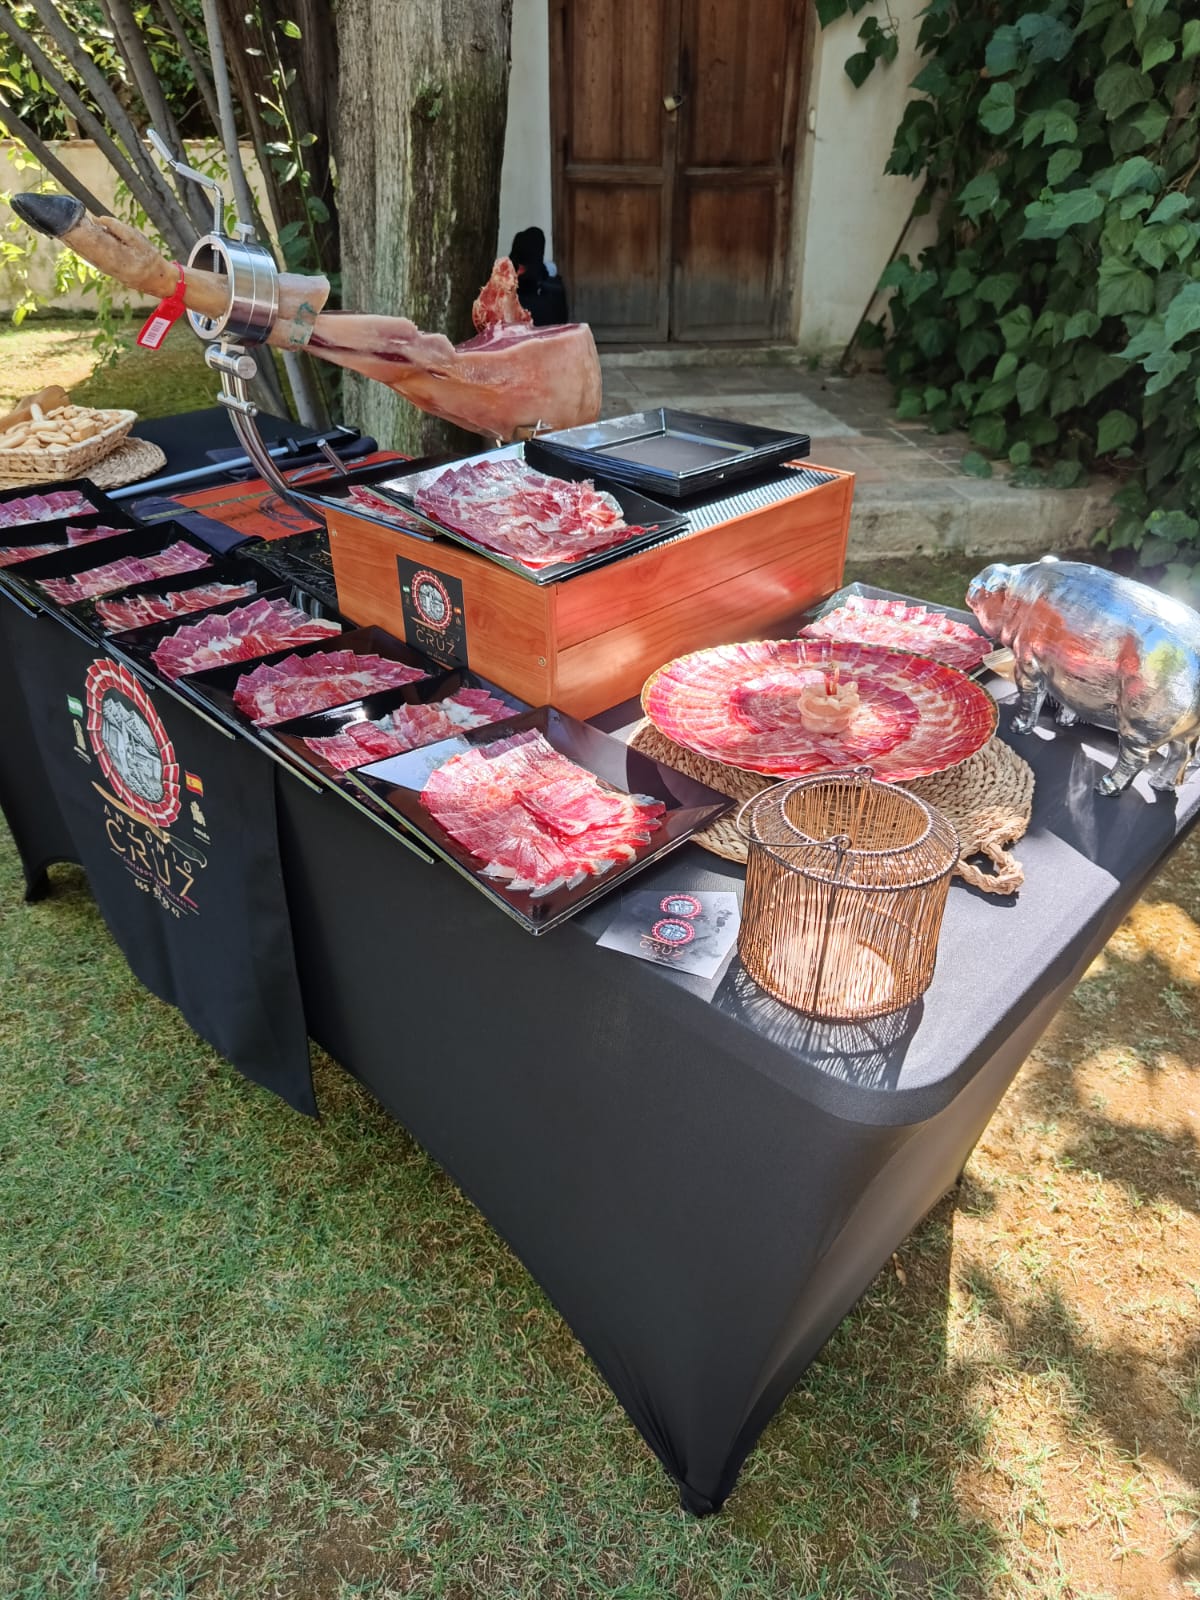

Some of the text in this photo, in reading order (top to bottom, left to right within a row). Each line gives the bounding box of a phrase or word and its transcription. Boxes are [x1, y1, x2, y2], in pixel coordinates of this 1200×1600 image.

[416, 627, 456, 657] CRUZ
[104, 804, 192, 873] ANTONIO
[105, 818, 199, 909] CRUZ
